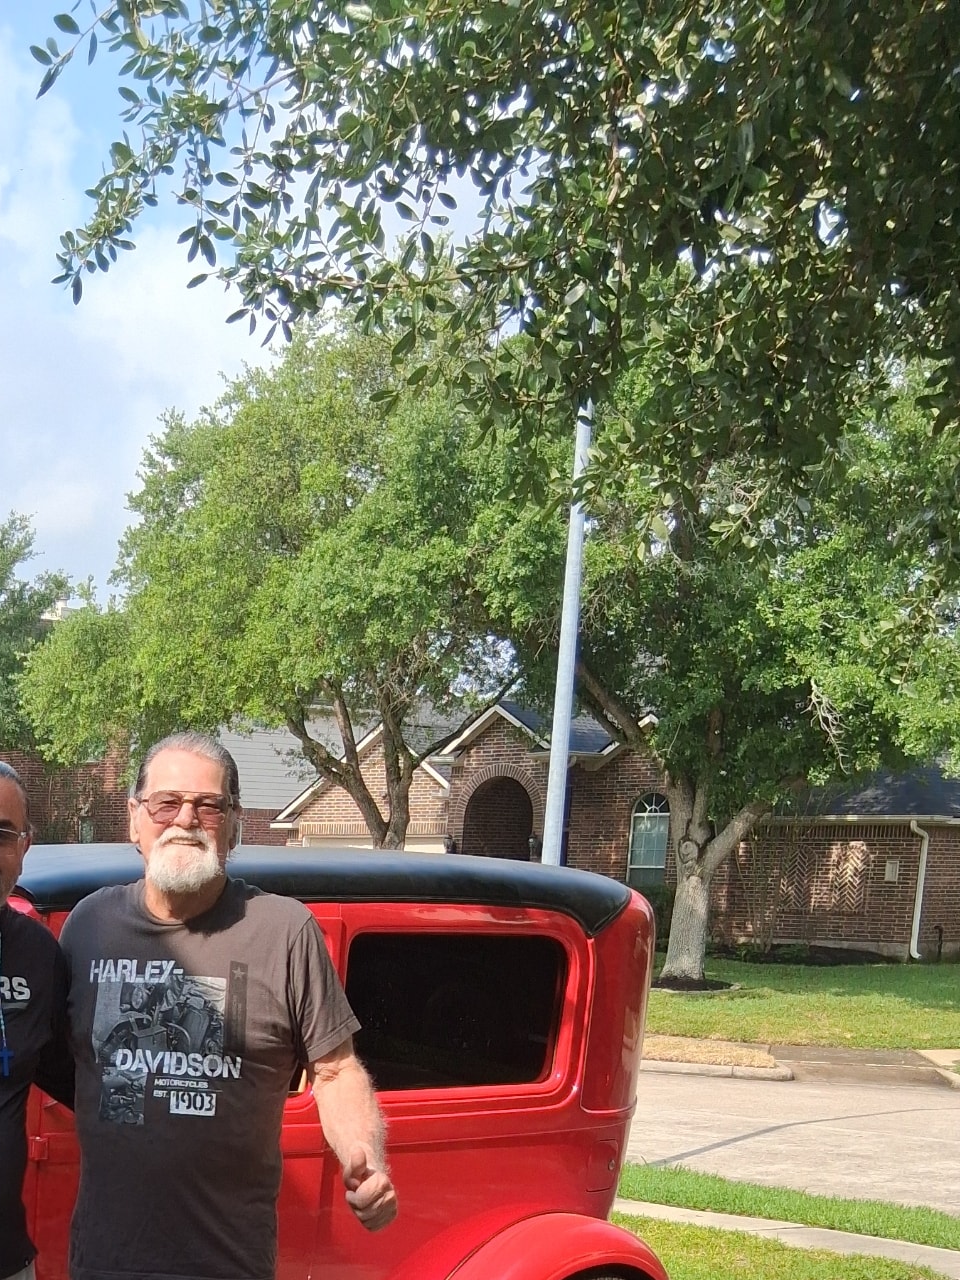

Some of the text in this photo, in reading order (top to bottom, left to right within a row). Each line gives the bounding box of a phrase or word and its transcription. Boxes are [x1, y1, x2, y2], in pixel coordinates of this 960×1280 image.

[90, 958, 184, 984] HARLEY-
[115, 1048, 242, 1079] DAVIDSON
[154, 1078, 209, 1089] MOTORCYCLES
[172, 1090, 215, 1112] 1903
